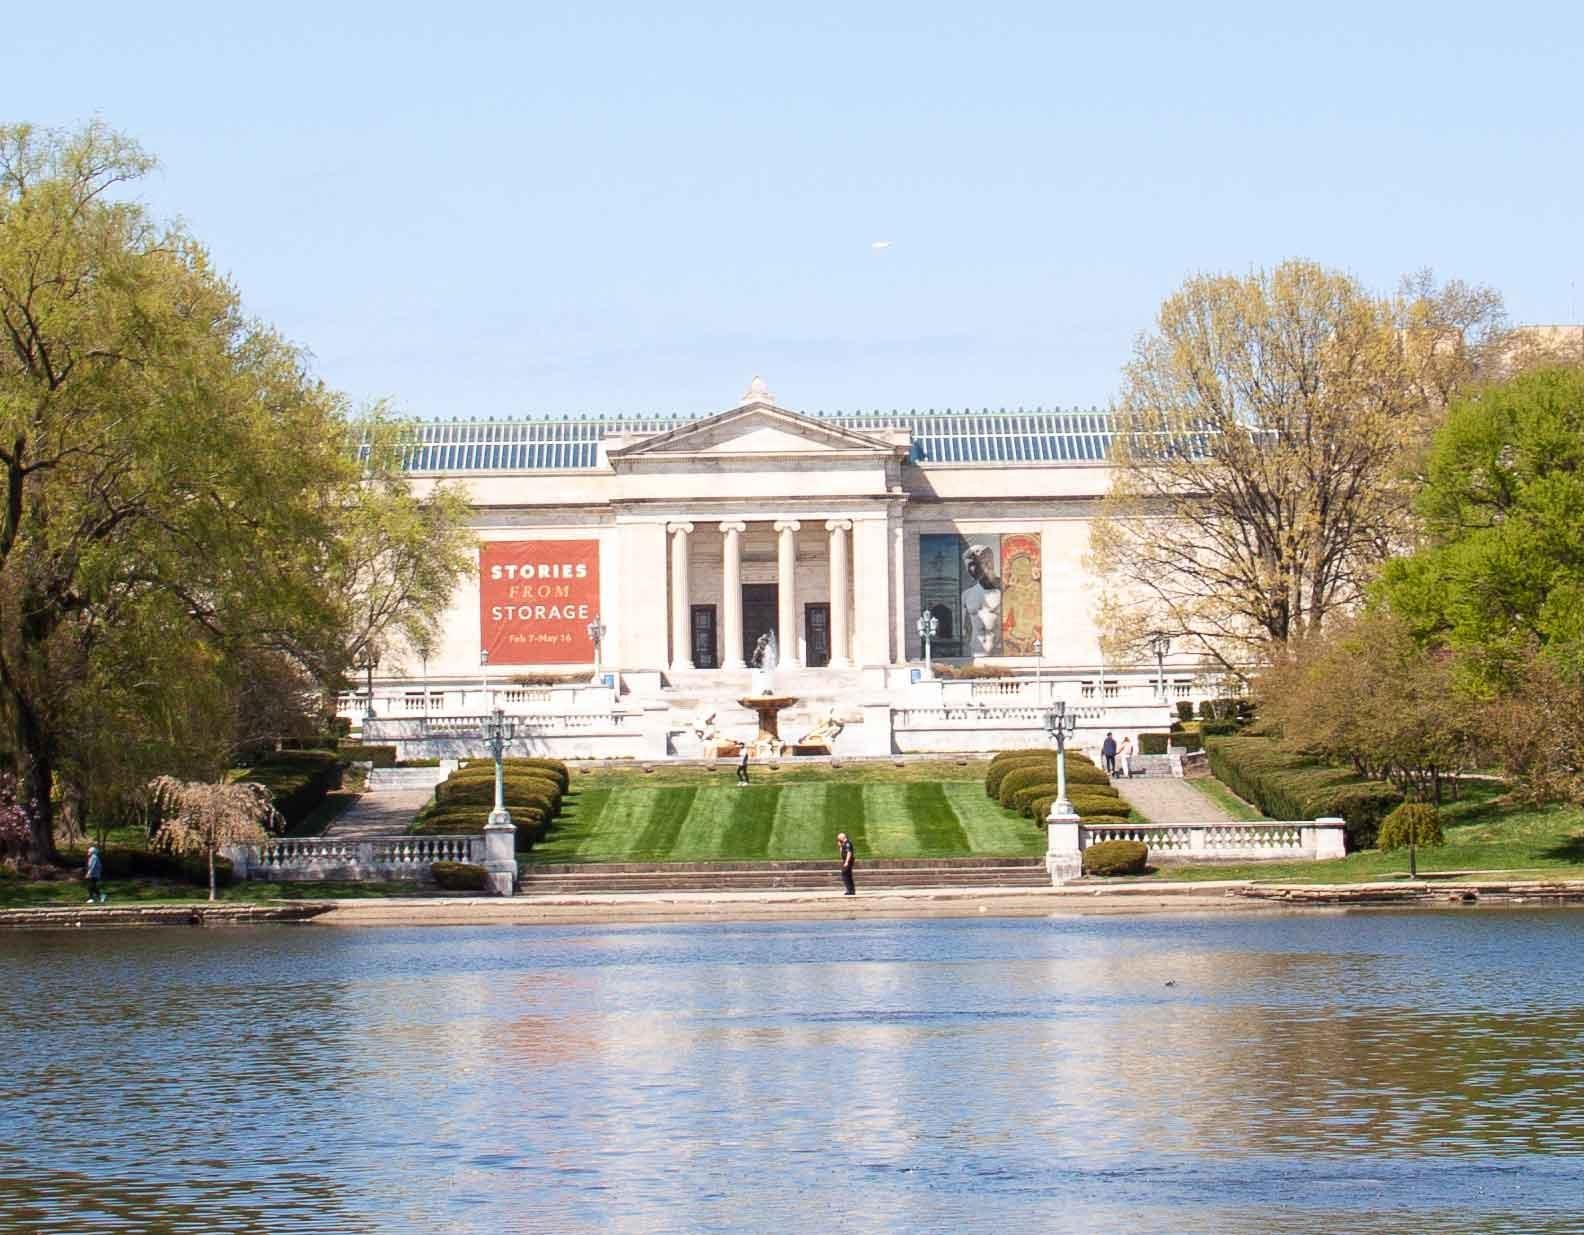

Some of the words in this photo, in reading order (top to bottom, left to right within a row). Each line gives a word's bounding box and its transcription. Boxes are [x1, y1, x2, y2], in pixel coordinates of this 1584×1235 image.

[491, 564, 587, 579] STORIES
[510, 585, 569, 598] FROM
[492, 605, 589, 620] STORAGE
